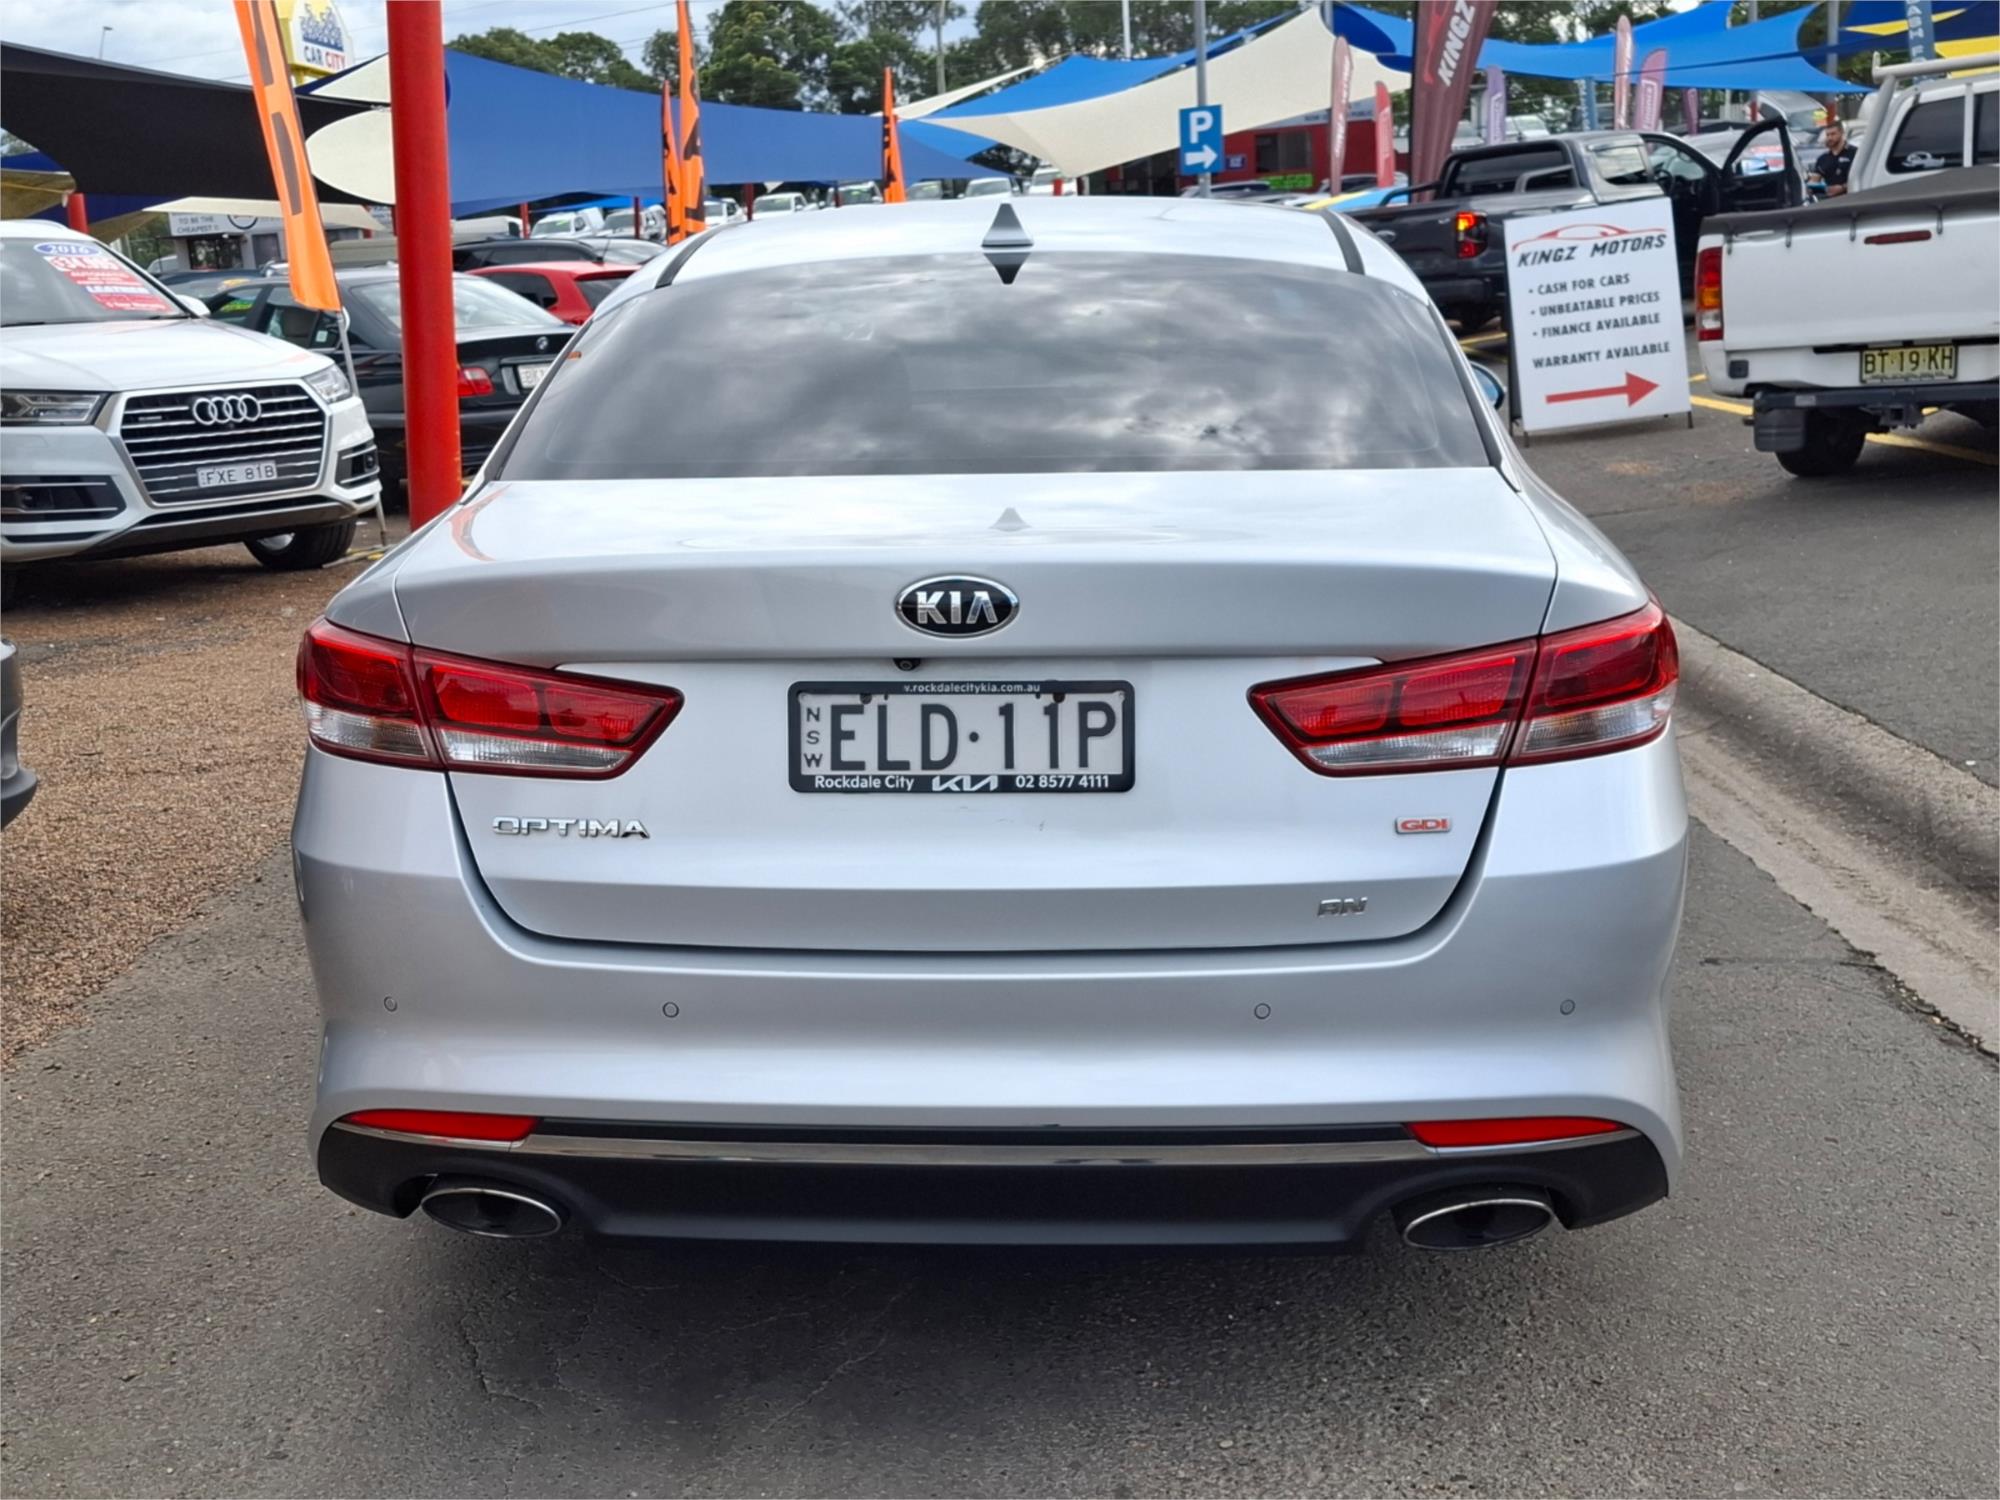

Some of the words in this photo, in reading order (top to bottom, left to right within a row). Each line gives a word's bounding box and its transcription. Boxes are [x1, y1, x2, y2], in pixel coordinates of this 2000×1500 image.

[1906, 0, 1924, 40] ASH
[1438, 0, 1476, 87] KINGZ
[304, 45, 325, 67] CAR
[325, 51, 346, 71] CITY
[1189, 110, 1214, 145] P
[1517, 246, 1578, 268] KINGZ
[1590, 234, 1667, 258] MOTORS
[1537, 282, 1568, 296] CASH
[1572, 279, 1595, 291] FOR
[1600, 273, 1631, 287] CARS
[1539, 297, 1615, 317] UNBEATABLE
[1619, 291, 1661, 306] PRICES
[1541, 321, 1592, 338] FINANCE
[1596, 313, 1661, 331] AVAILABLE
[1532, 350, 1601, 369] WARRANTY
[1606, 341, 1671, 360] AVAILABLE
[206, 469, 238, 485] FXE
[244, 464, 275, 481] 81B
[915, 591, 999, 625] KIA
[814, 775, 881, 789] Rockdale
[885, 775, 914, 793] City
[1015, 775, 1034, 788] 02
[1038, 775, 1074, 788] 8577
[1078, 774, 1110, 788] 4111
[492, 816, 650, 839] OPTIMA
[1400, 818, 1448, 831] GDI
